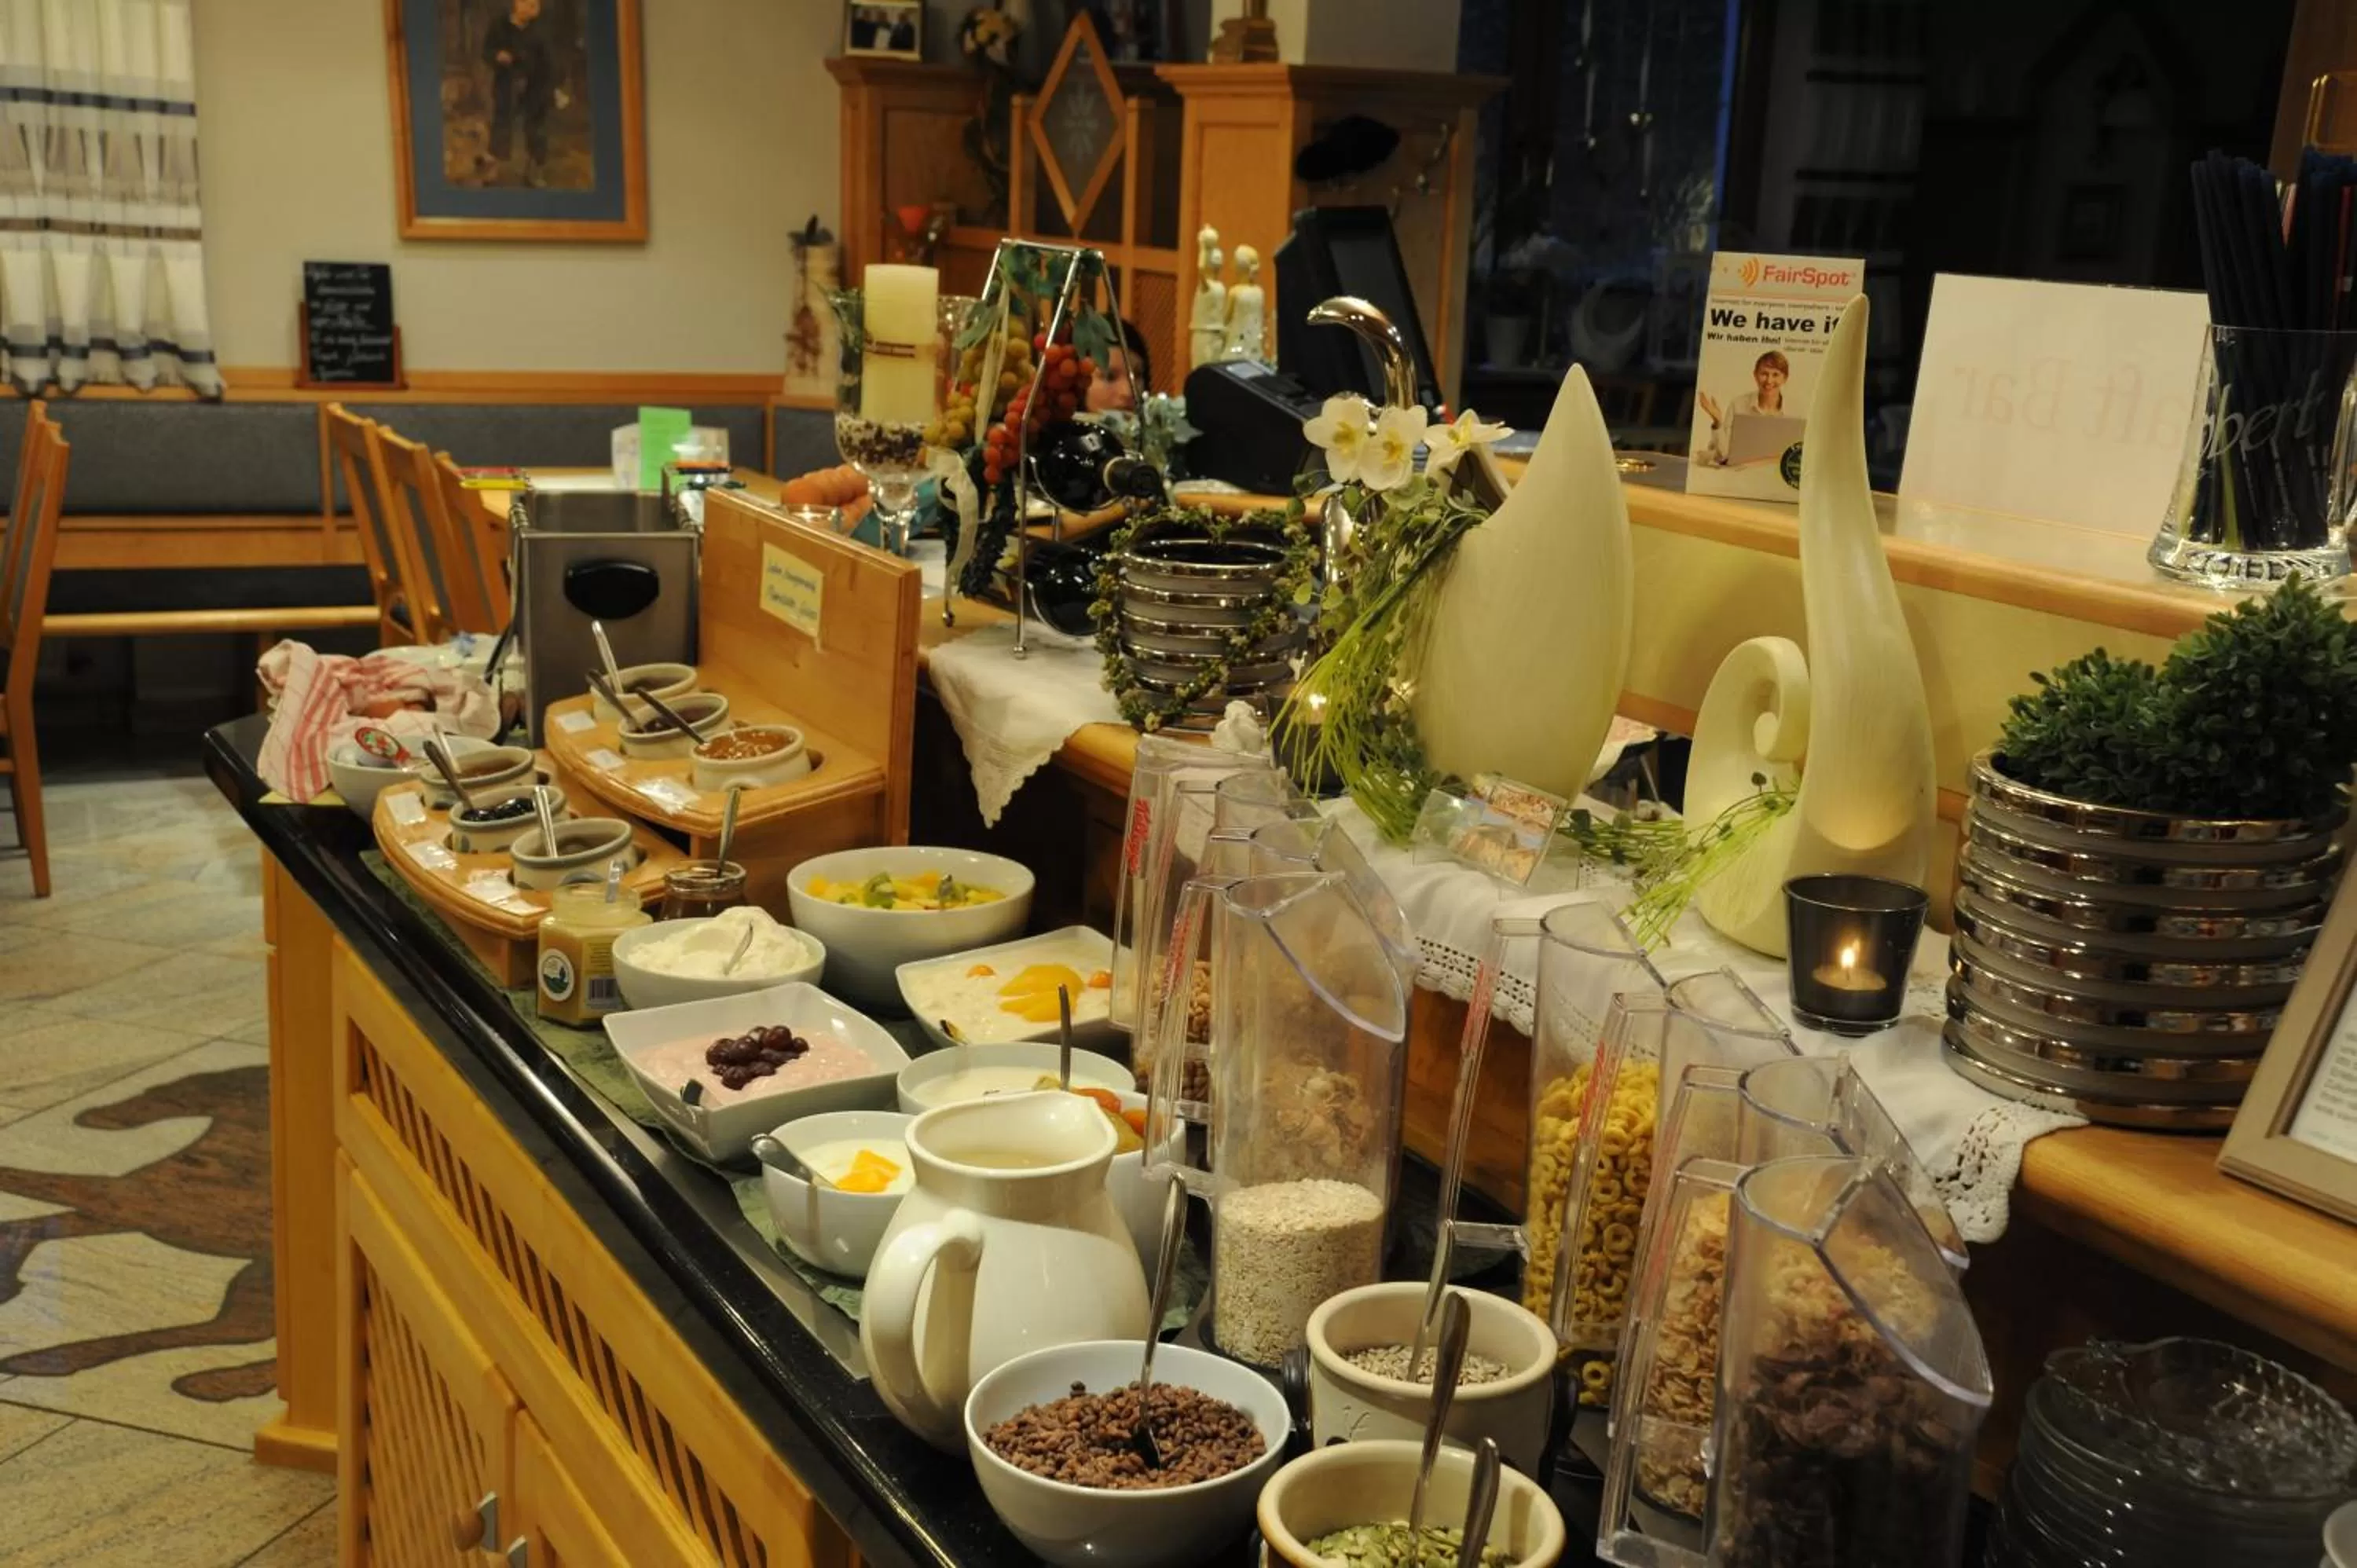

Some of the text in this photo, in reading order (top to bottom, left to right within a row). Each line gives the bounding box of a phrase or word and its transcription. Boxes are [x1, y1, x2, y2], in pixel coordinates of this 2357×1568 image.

[1763, 265, 1851, 288] FairSpot
[1710, 308, 1747, 328] We
[1755, 311, 1816, 332] have
[1707, 332, 1724, 340] Wir
[1726, 333, 1759, 343] haben
